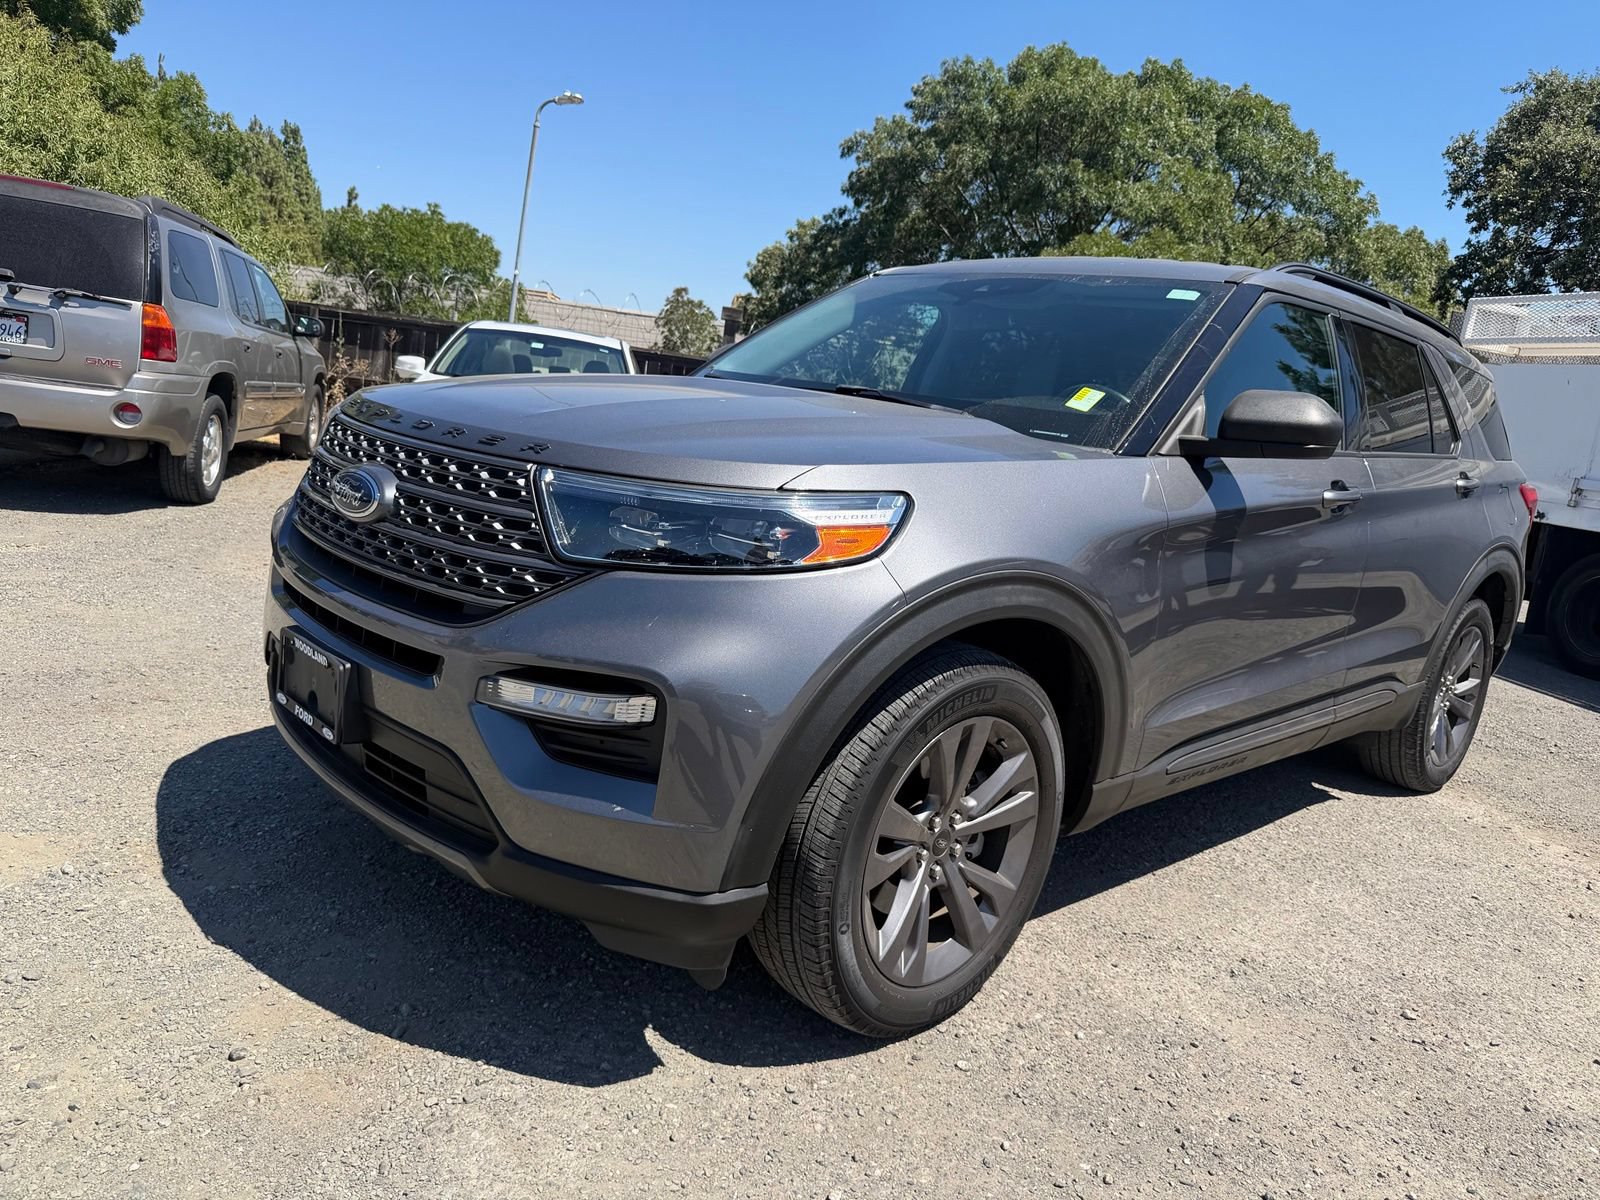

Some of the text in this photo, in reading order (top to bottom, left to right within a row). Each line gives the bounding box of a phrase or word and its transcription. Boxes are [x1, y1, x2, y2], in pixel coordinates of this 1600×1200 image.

[814, 512, 888, 521] EXPLORER
[293, 637, 329, 667] WOODLAND
[294, 704, 313, 726] FORD
[926, 686, 996, 732] MICHELIN
